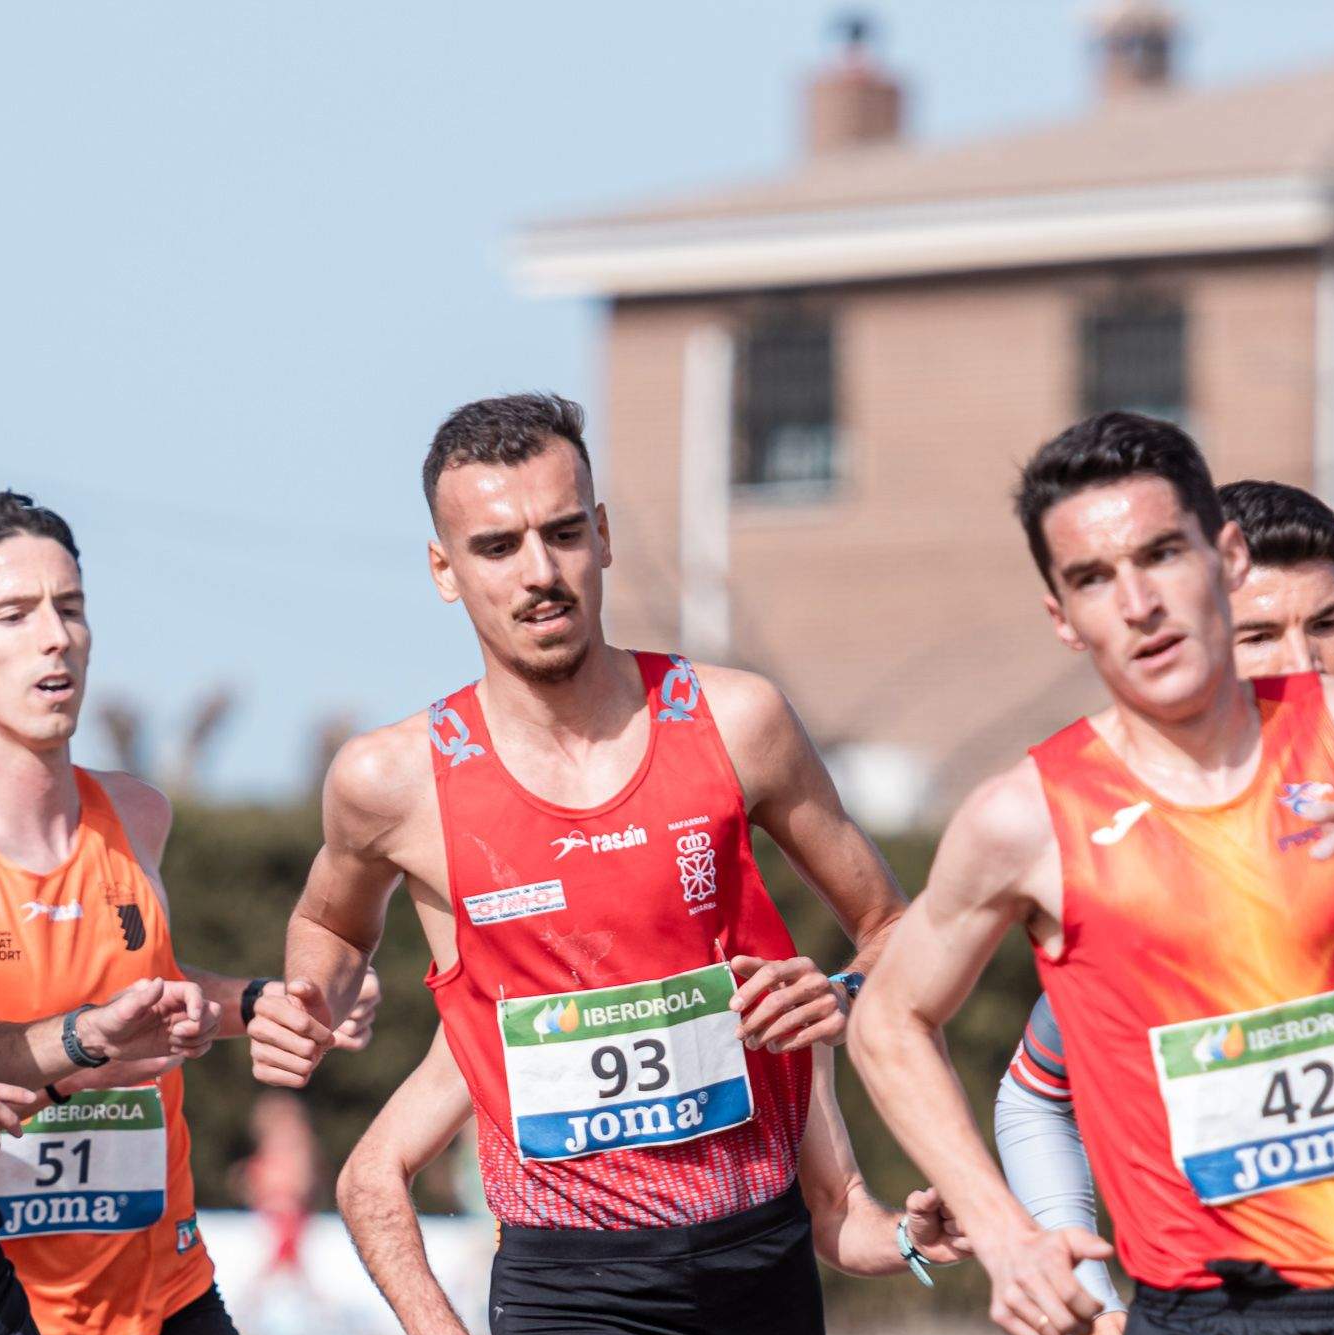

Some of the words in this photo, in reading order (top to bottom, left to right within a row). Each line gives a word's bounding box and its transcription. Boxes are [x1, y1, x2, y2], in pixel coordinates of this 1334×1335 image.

[591, 823, 648, 853] rasán
[583, 987, 706, 1027] IBERDROLA
[590, 1038, 671, 1099] 93
[37, 1102, 145, 1123] IBERDROLA
[35, 1138, 92, 1187] 51
